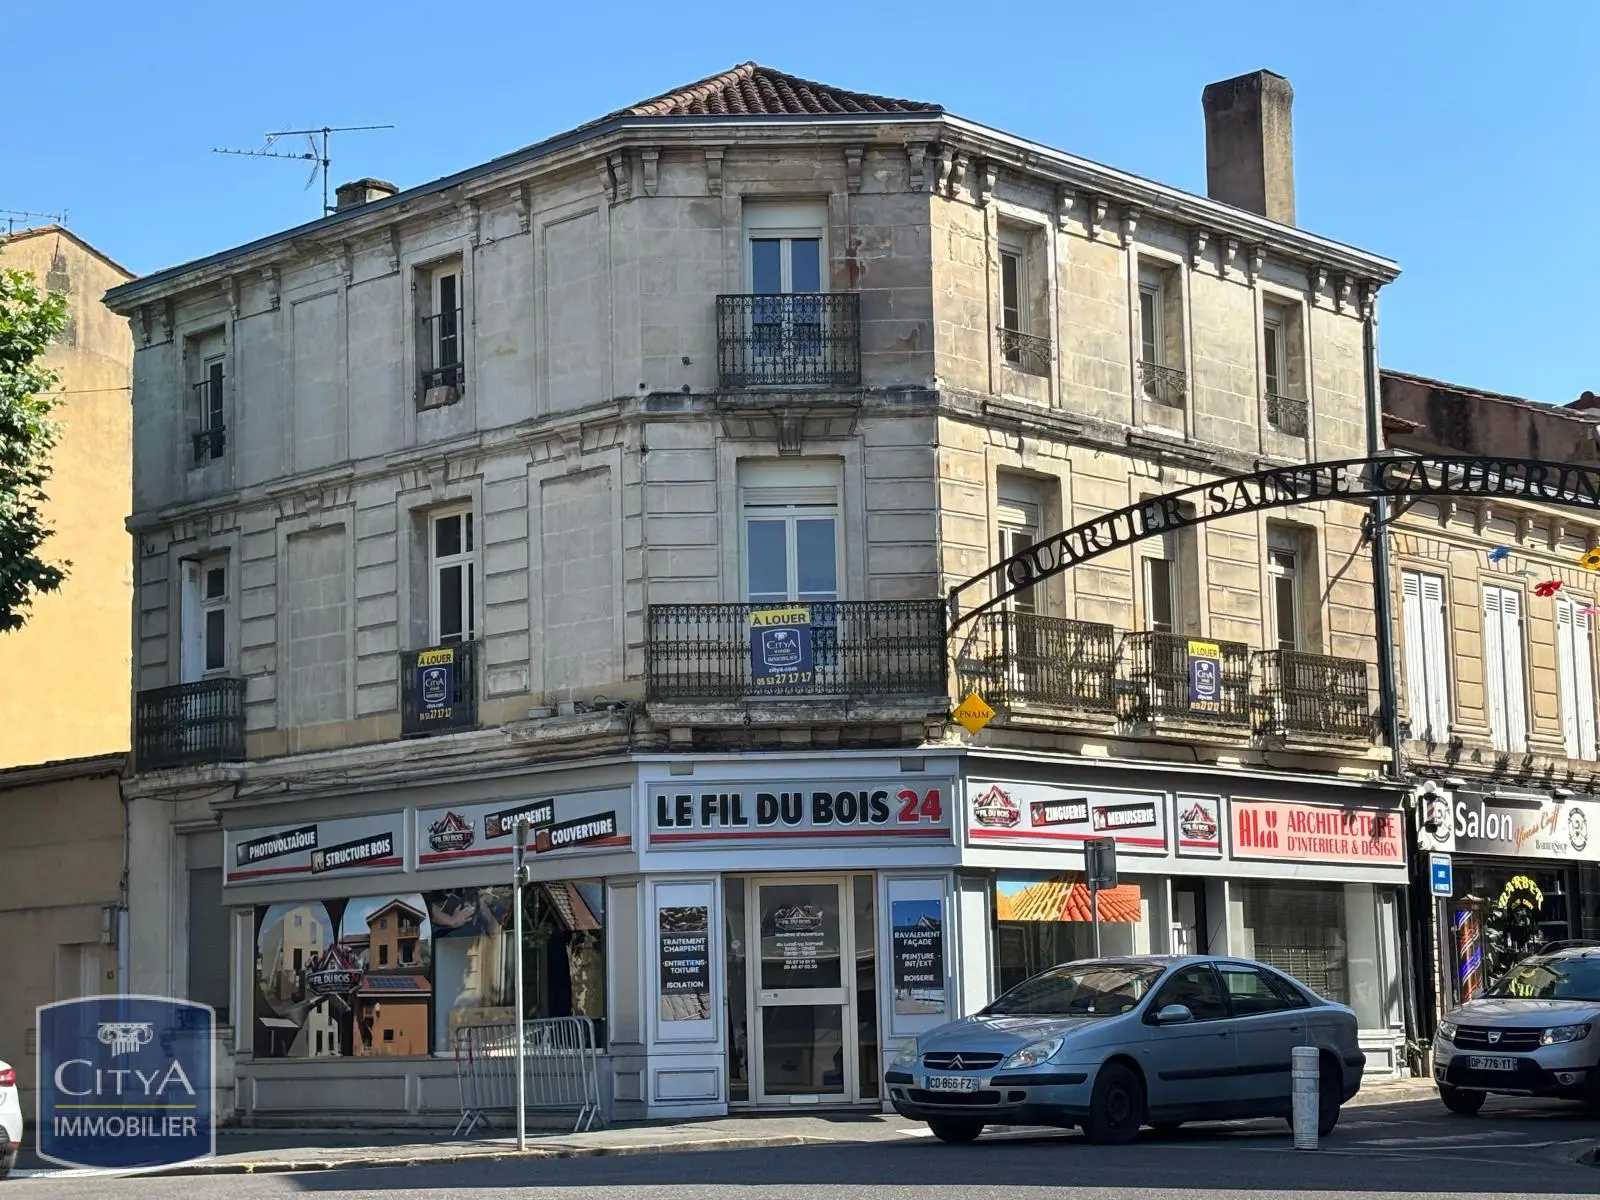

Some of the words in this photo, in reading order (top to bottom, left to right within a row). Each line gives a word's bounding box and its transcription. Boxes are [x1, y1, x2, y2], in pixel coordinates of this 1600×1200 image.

[1007, 498, 1190, 585] QUARTIER
[1207, 465, 1349, 514] SAINTE
[765, 613, 806, 625] LOUER
[1196, 648, 1217, 657] LOUER
[427, 654, 452, 664] LOUER
[775, 674, 787, 684] 27
[788, 673, 799, 683] 17
[801, 672, 812, 682] 17
[959, 710, 989, 719] FNAIM
[656, 793, 693, 829] LE
[699, 792, 748, 829] FIL
[755, 791, 803, 827] DU
[811, 789, 889, 827] BOIS
[896, 788, 942, 825] 24
[1045, 804, 1087, 822] ZINGUERIE
[1107, 808, 1154, 826] MENUISERIE
[1455, 801, 1513, 841] Salon
[1287, 810, 1396, 839] ARCHITECTURE
[551, 818, 613, 845] COUVERTURE
[249, 831, 316, 860] PHOTOVOLTAÏQUE
[1287, 837, 1348, 854] D'INTERIEUR
[1352, 842, 1359, 855] &
[1361, 840, 1397, 857] DESIGN
[325, 845, 371, 867] STRUCTURE
[371, 839, 391, 857] BOIS
[895, 931, 940, 939] RAVALEMENT
[663, 937, 706, 946] TRAITEMENT
[903, 939, 932, 948] FAÇADE
[663, 944, 705, 953] CHARPENTE
[665, 959, 705, 967] ENTRETIENS
[905, 960, 932, 968] INT/EXT
[323, 974, 333, 983] DU
[334, 974, 350, 983] BOIS
[904, 974, 935, 982] BOISERIE
[666, 981, 704, 989] ISOLATION
